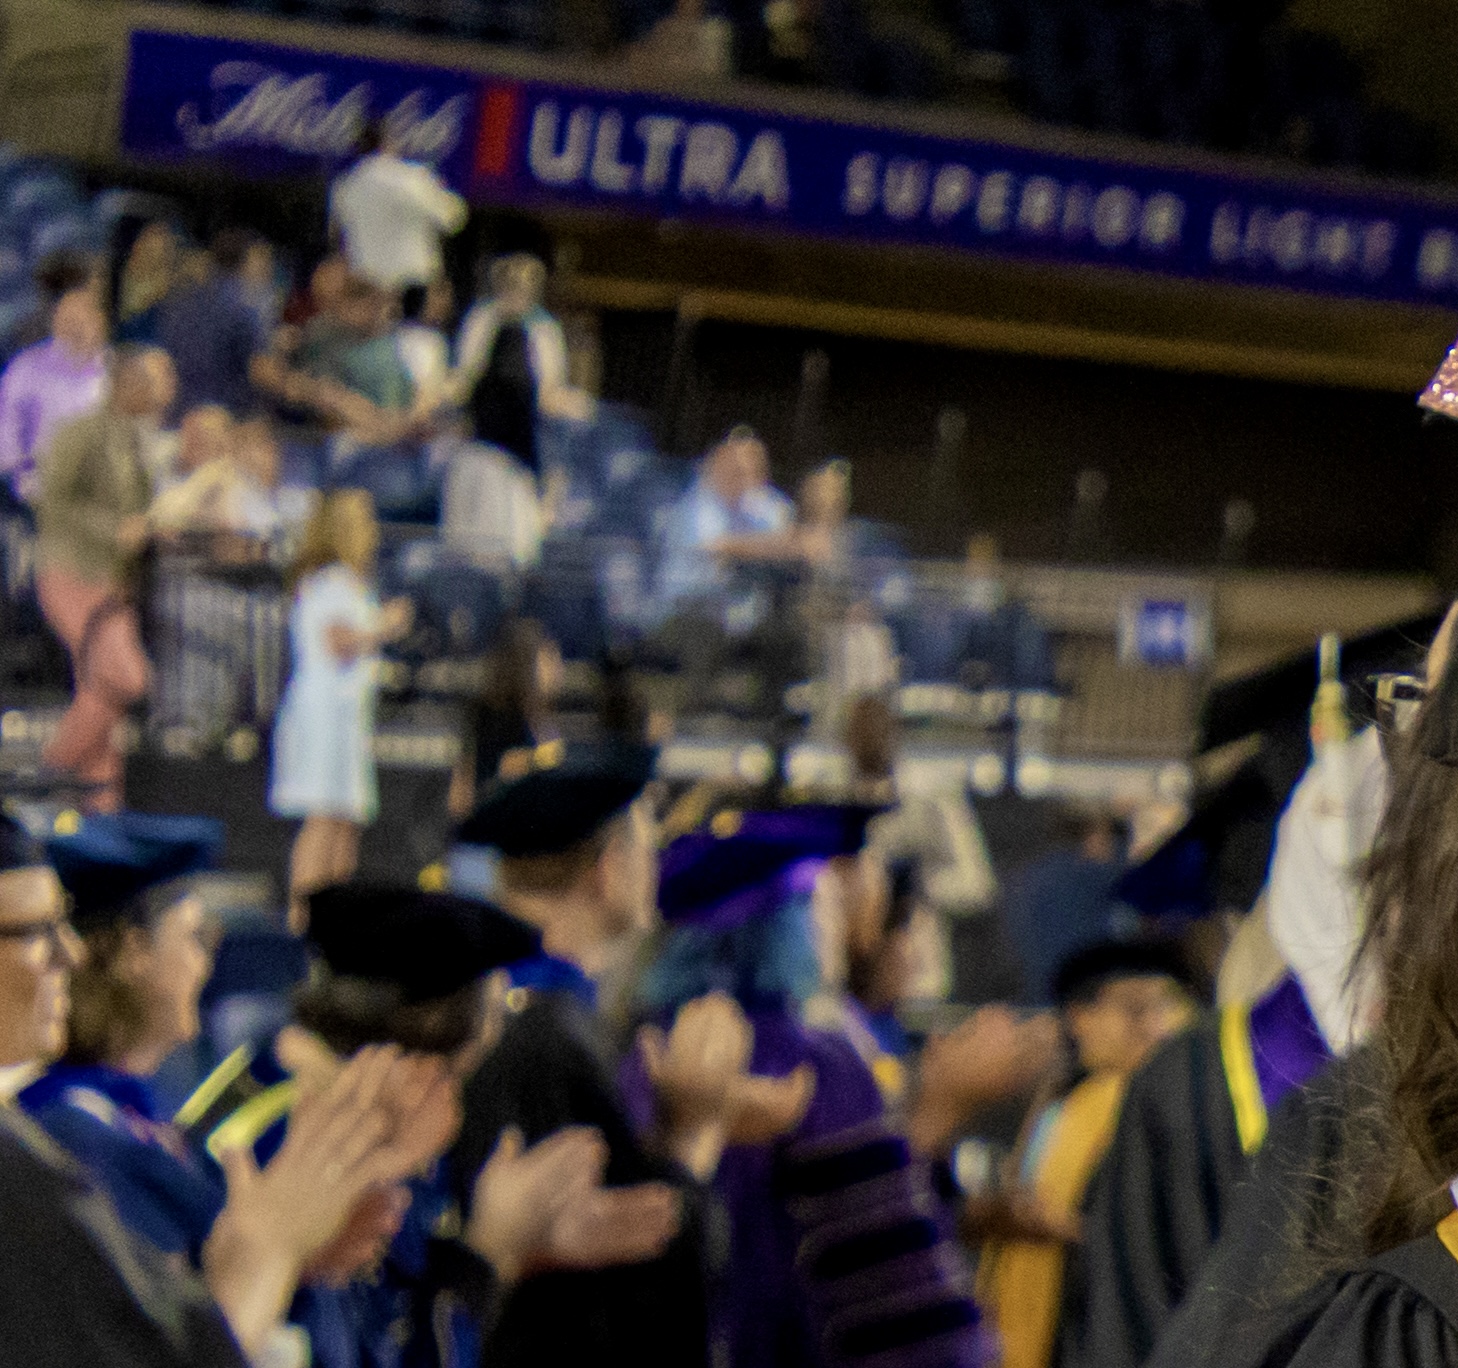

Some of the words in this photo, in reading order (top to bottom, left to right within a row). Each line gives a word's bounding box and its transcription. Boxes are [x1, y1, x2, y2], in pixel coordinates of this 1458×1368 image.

[527, 100, 790, 212] ULTRA
[842, 150, 1187, 256] SUPERIOR
[1210, 202, 1396, 280] LIGHT
